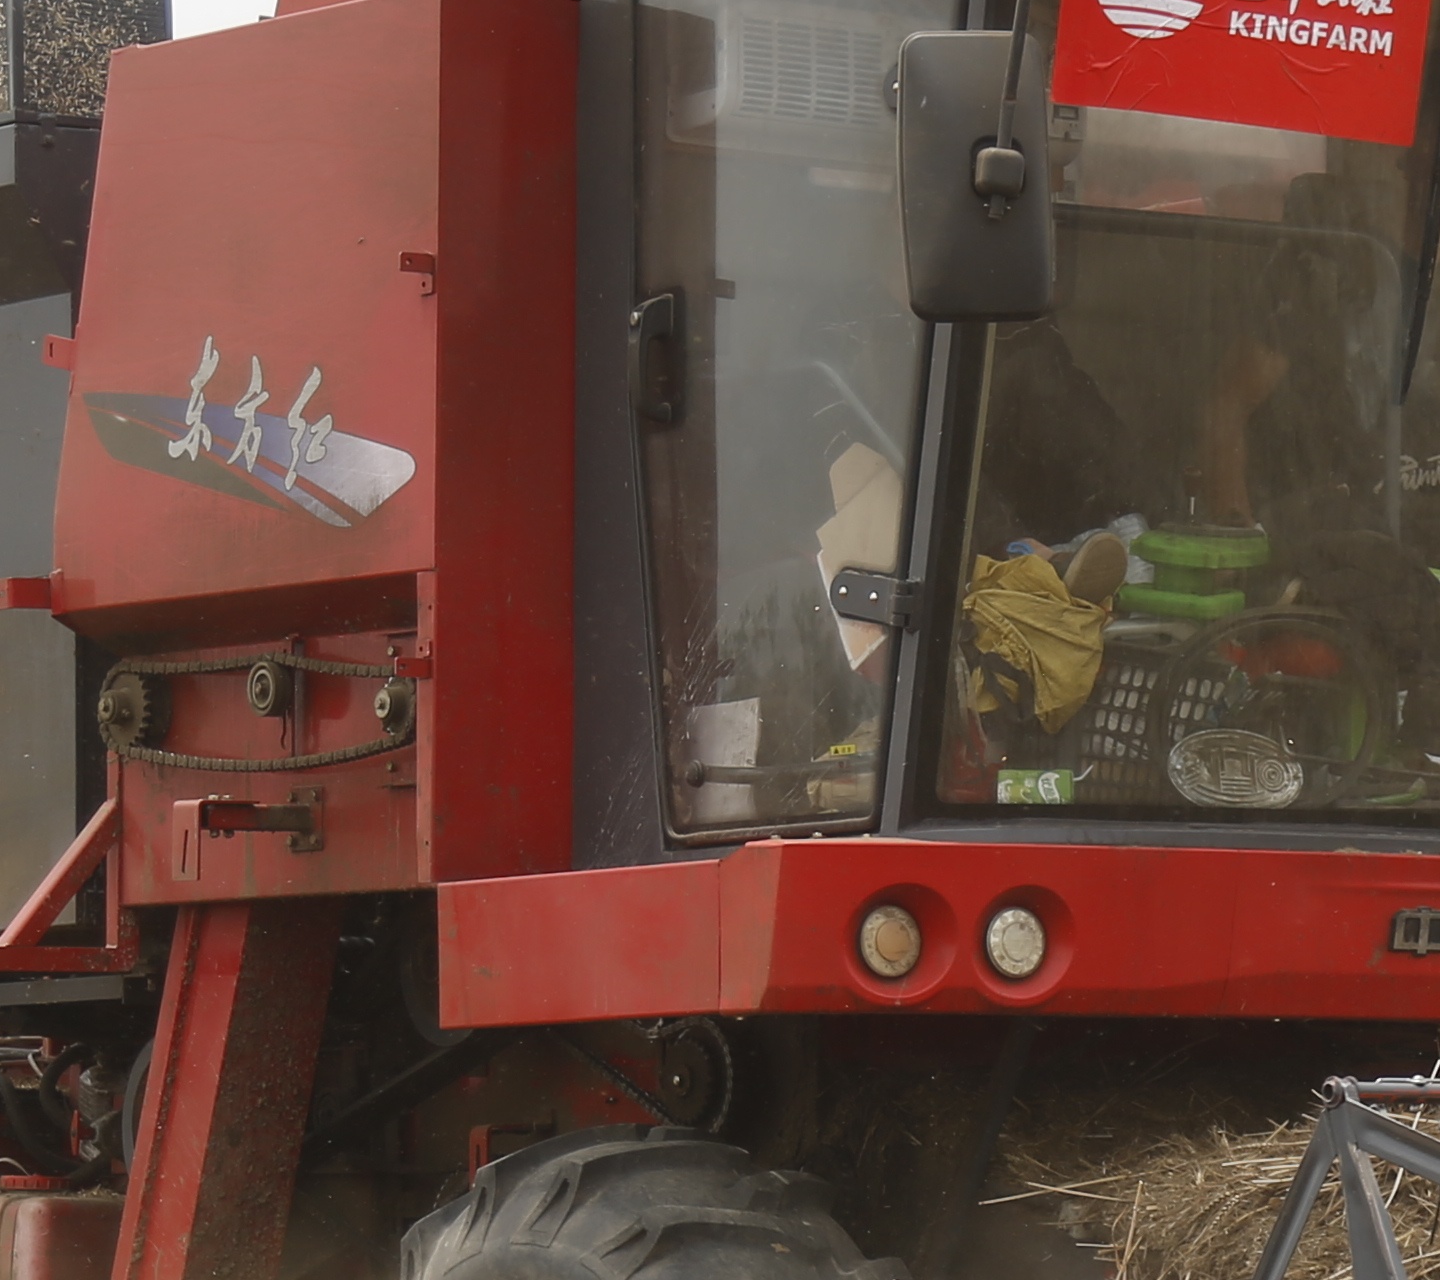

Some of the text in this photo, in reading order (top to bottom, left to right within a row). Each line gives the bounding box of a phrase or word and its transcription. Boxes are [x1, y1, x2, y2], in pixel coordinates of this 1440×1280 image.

[1228, 10, 1394, 57] KINGFARM
[167, 335, 334, 491] 东方红
